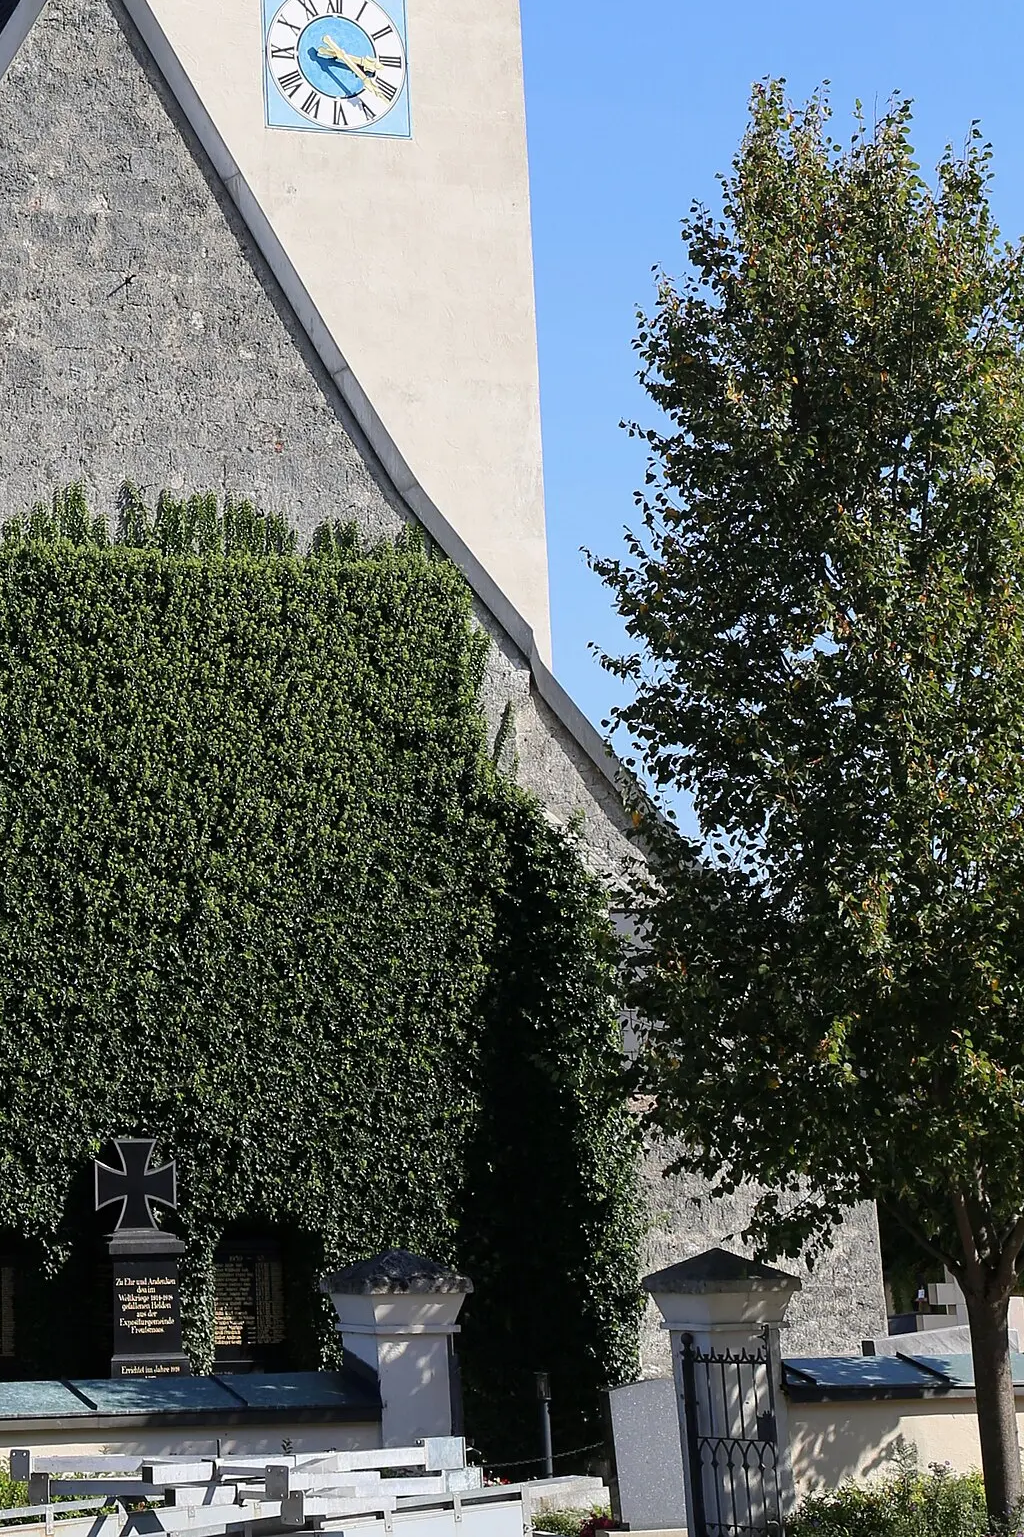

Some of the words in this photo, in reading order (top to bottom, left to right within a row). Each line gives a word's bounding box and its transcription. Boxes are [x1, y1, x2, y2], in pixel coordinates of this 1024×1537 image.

[355, 0, 369, 22] I
[277, 14, 302, 36] X
[370, 24, 394, 41] II
[270, 43, 295, 60] IX
[378, 55, 402, 69] III
[277, 69, 303, 99] VIII
[300, 90, 321, 120] VII
[332, 100, 349, 126] VI
[360, 98, 377, 121] V
[115, 1277, 124, 1286] Zu
[136, 1277, 147, 1286] und
[148, 1276, 176, 1286] Andenken
[148, 1285, 156, 1293] im
[118, 1293, 149, 1303] Weltkriege
[121, 1302, 150, 1311] gefallenen
[151, 1301, 172, 1310] Helden
[147, 1309, 158, 1317] der
[121, 1365, 145, 1374] Errichtet
[154, 1364, 170, 1373] Jahre
